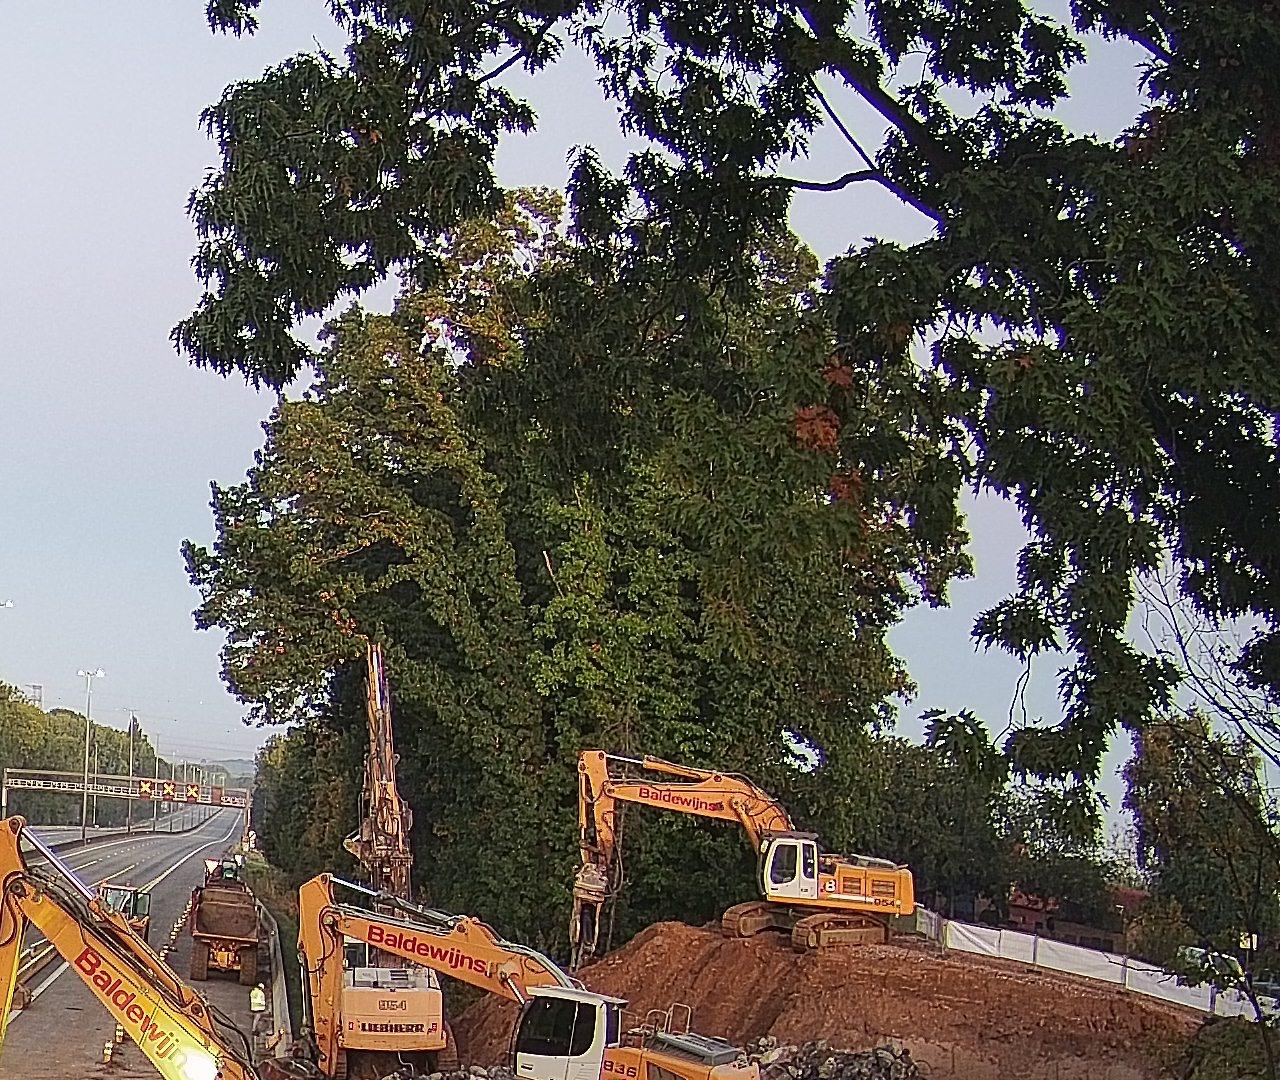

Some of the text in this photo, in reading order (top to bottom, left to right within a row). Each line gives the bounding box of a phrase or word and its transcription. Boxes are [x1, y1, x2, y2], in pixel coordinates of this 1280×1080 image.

[639, 787, 717, 812] Baldewijns
[367, 924, 487, 974] Baldewijns
[361, 1022, 425, 1033] LIEBHERR
[603, 1060, 637, 1077] 936
